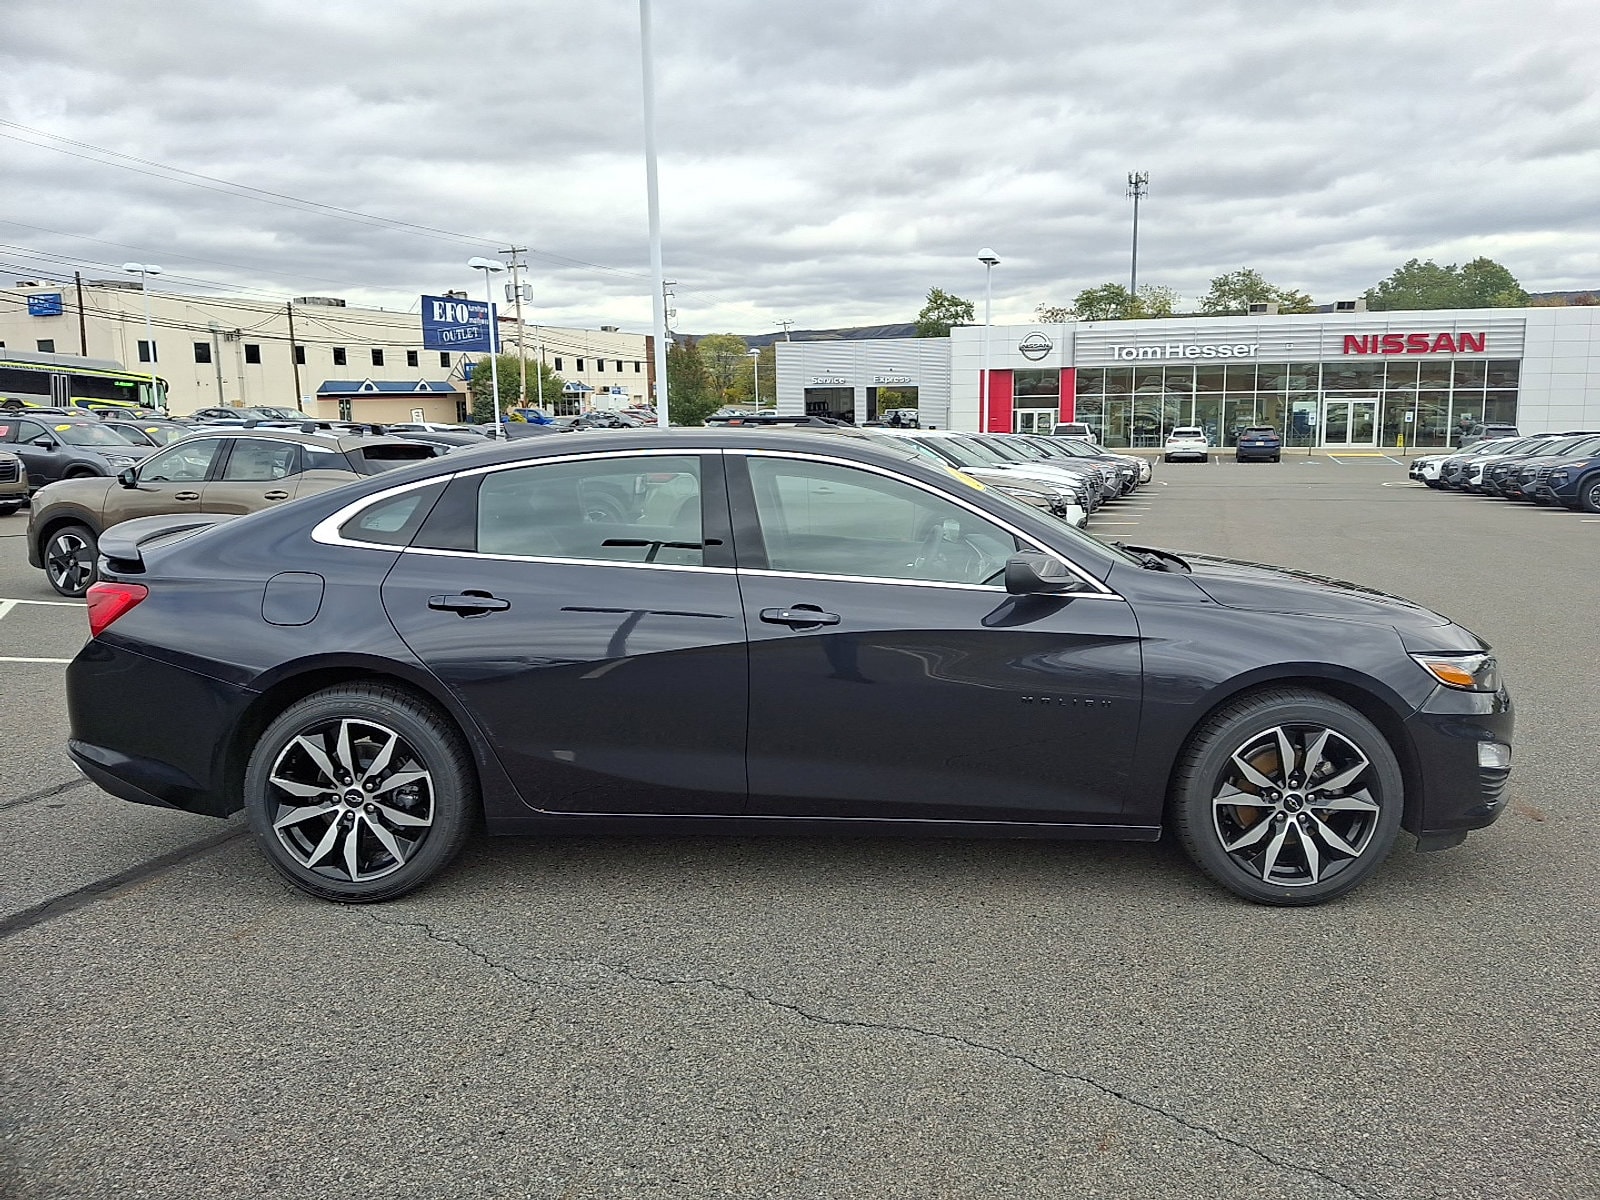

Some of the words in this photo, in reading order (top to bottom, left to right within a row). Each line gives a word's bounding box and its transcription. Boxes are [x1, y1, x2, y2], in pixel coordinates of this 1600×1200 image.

[432, 301, 469, 324] EFO
[443, 326, 479, 342] OUTLET
[1109, 344, 1161, 360] Tom
[1165, 342, 1259, 359] Hesser
[1343, 332, 1485, 355] NISSAN
[812, 376, 845, 384] Service
[873, 375, 911, 384] Express
